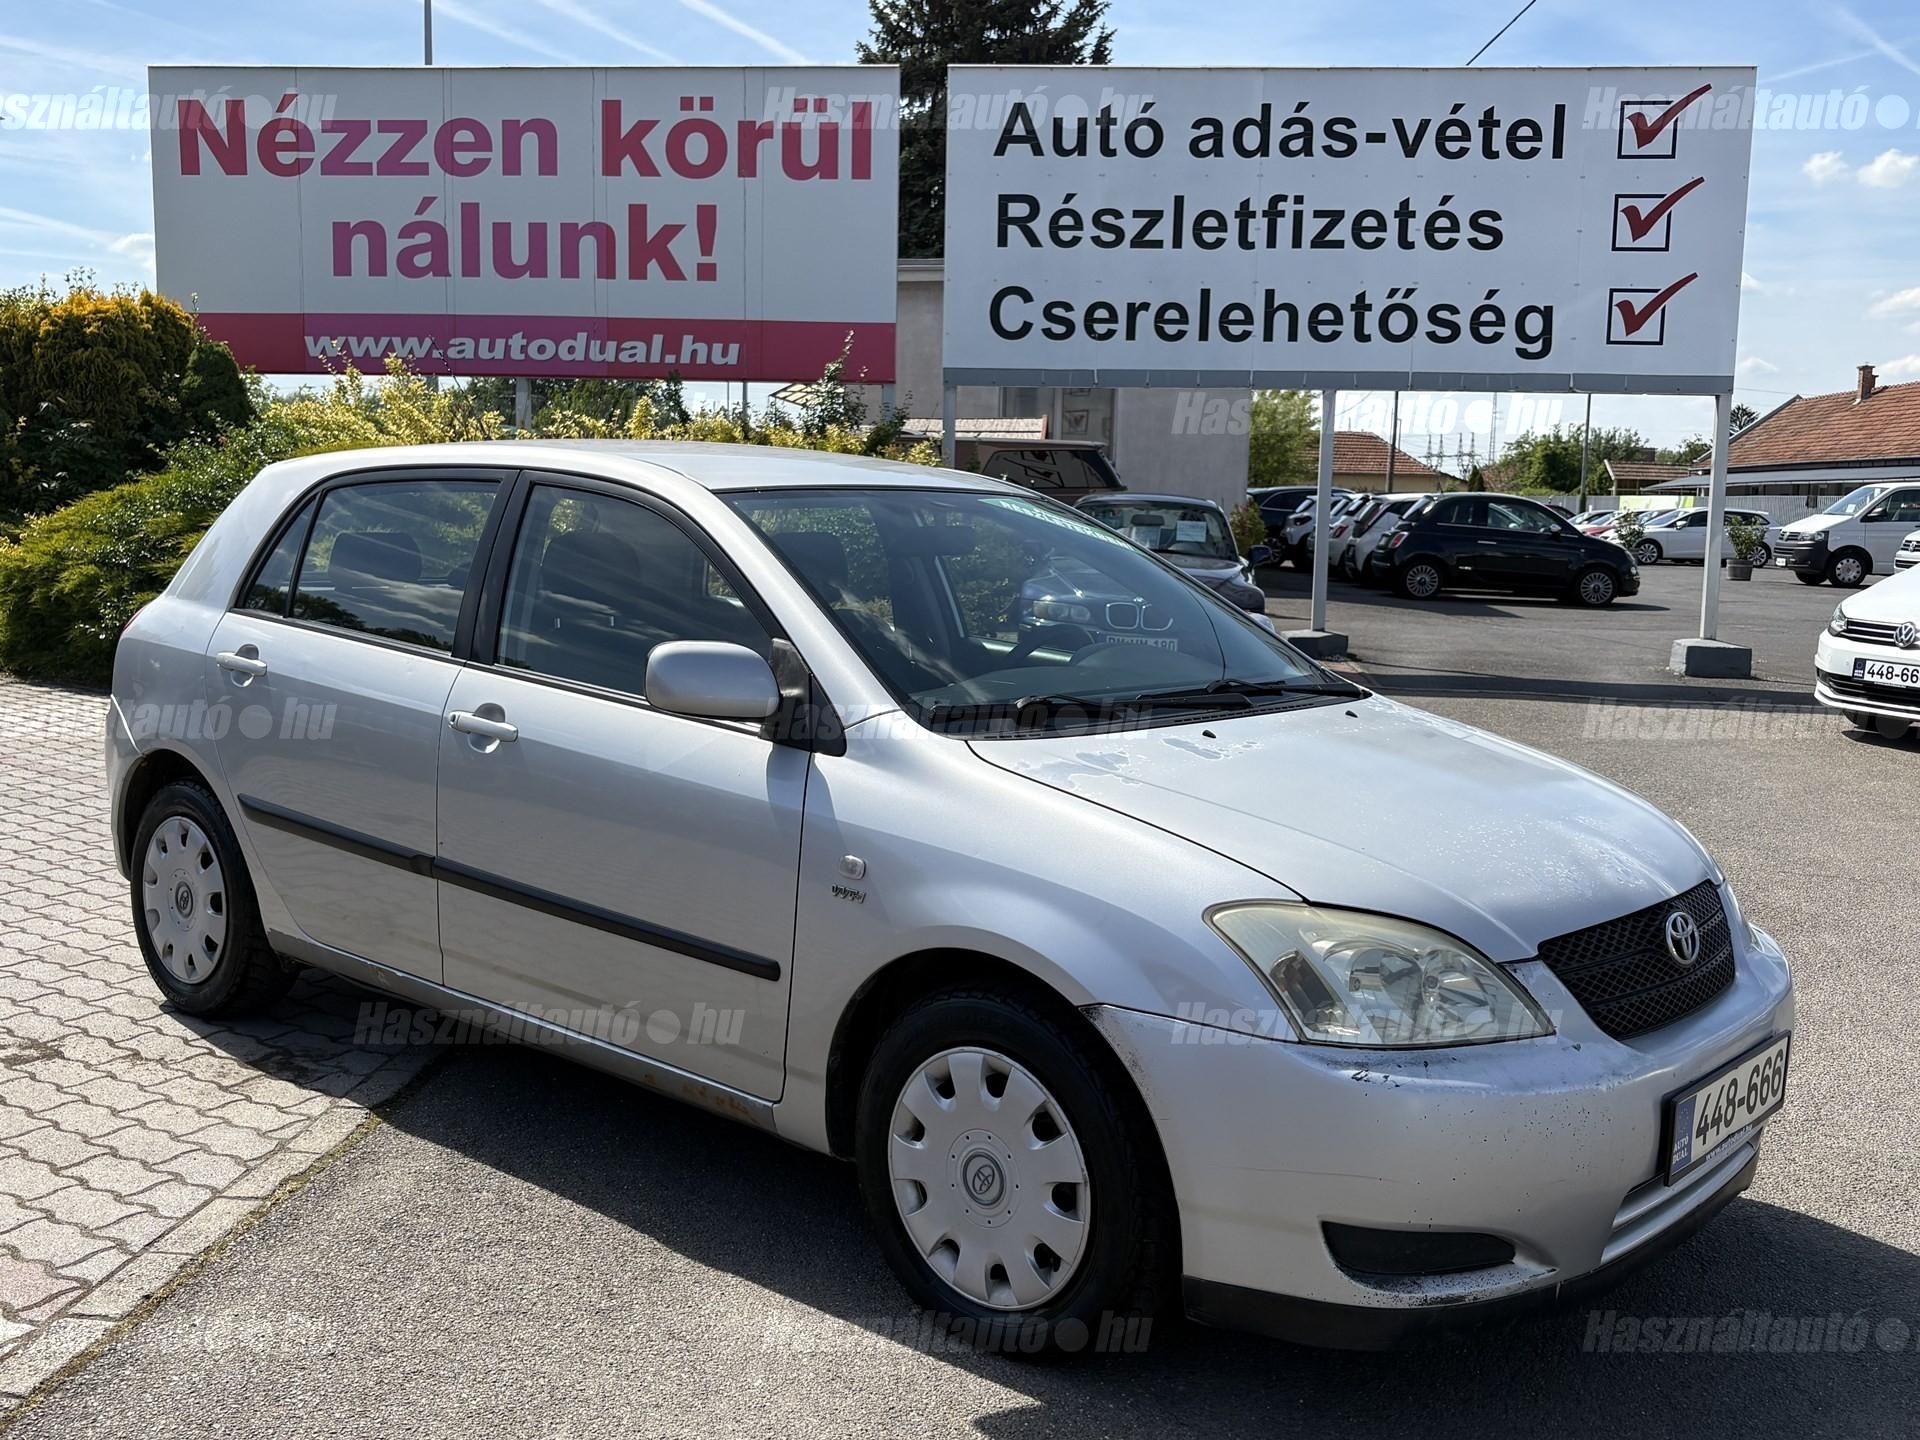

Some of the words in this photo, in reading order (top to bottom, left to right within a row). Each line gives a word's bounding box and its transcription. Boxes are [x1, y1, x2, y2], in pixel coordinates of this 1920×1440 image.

[178, 93, 559, 178] Nézzen
[601, 96, 872, 181] körül
[993, 101, 1166, 160] Autó
[1188, 102, 1566, 160] adás-vétel
[332, 196, 718, 282] nálunk!
[997, 193, 1504, 252] Részletfizetés
[305, 331, 741, 367] www.autodual.hu
[989, 285, 1554, 360] Cserelehetőség
[1695, 1048, 1784, 1146] 448-666
